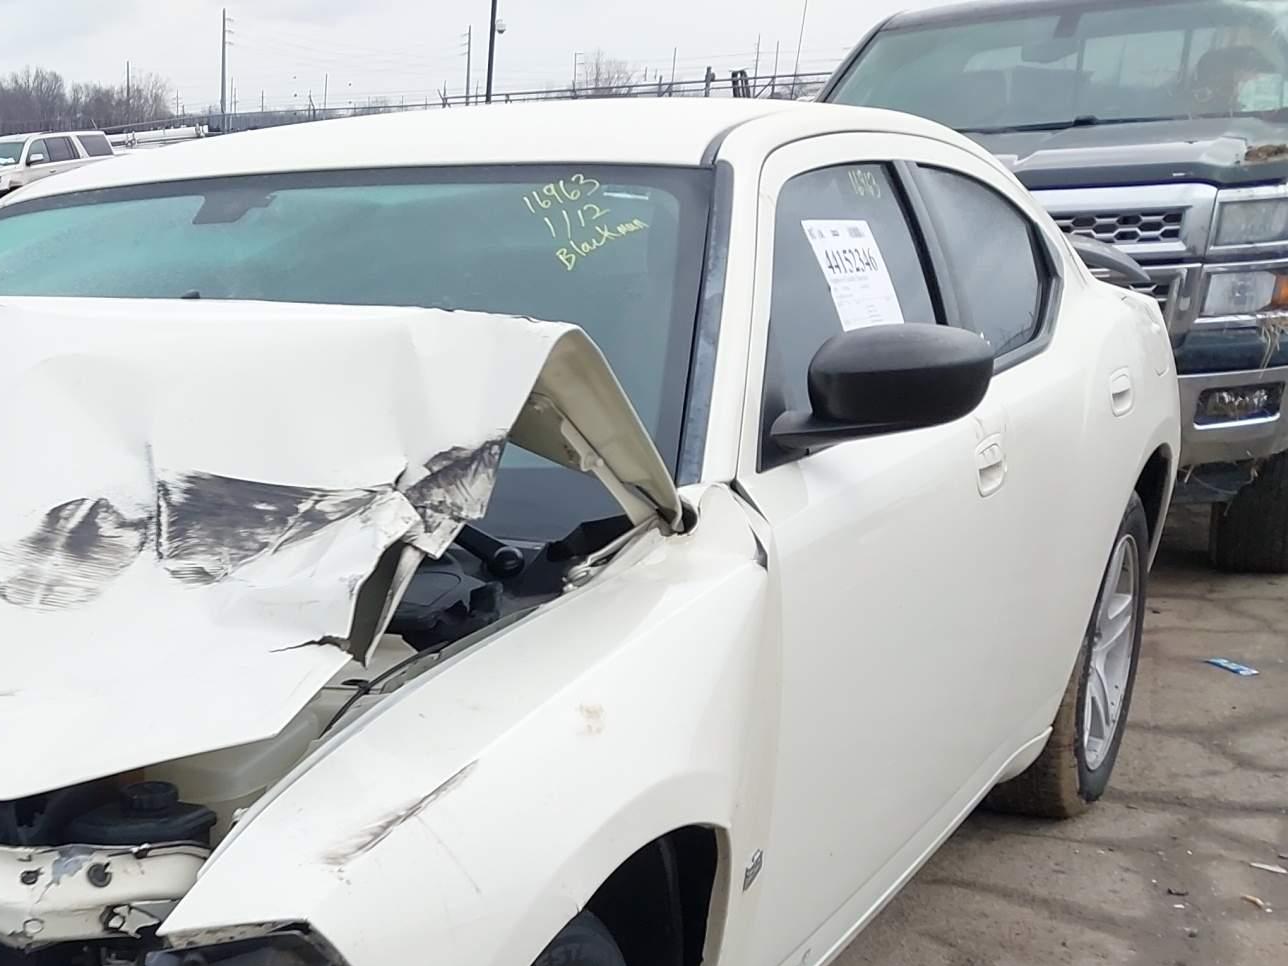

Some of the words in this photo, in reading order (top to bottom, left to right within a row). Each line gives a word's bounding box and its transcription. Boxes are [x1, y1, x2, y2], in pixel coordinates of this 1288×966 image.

[523, 173, 600, 213] 16963
[543, 204, 611, 239] 1/12
[825, 248, 879, 274] 44152346
